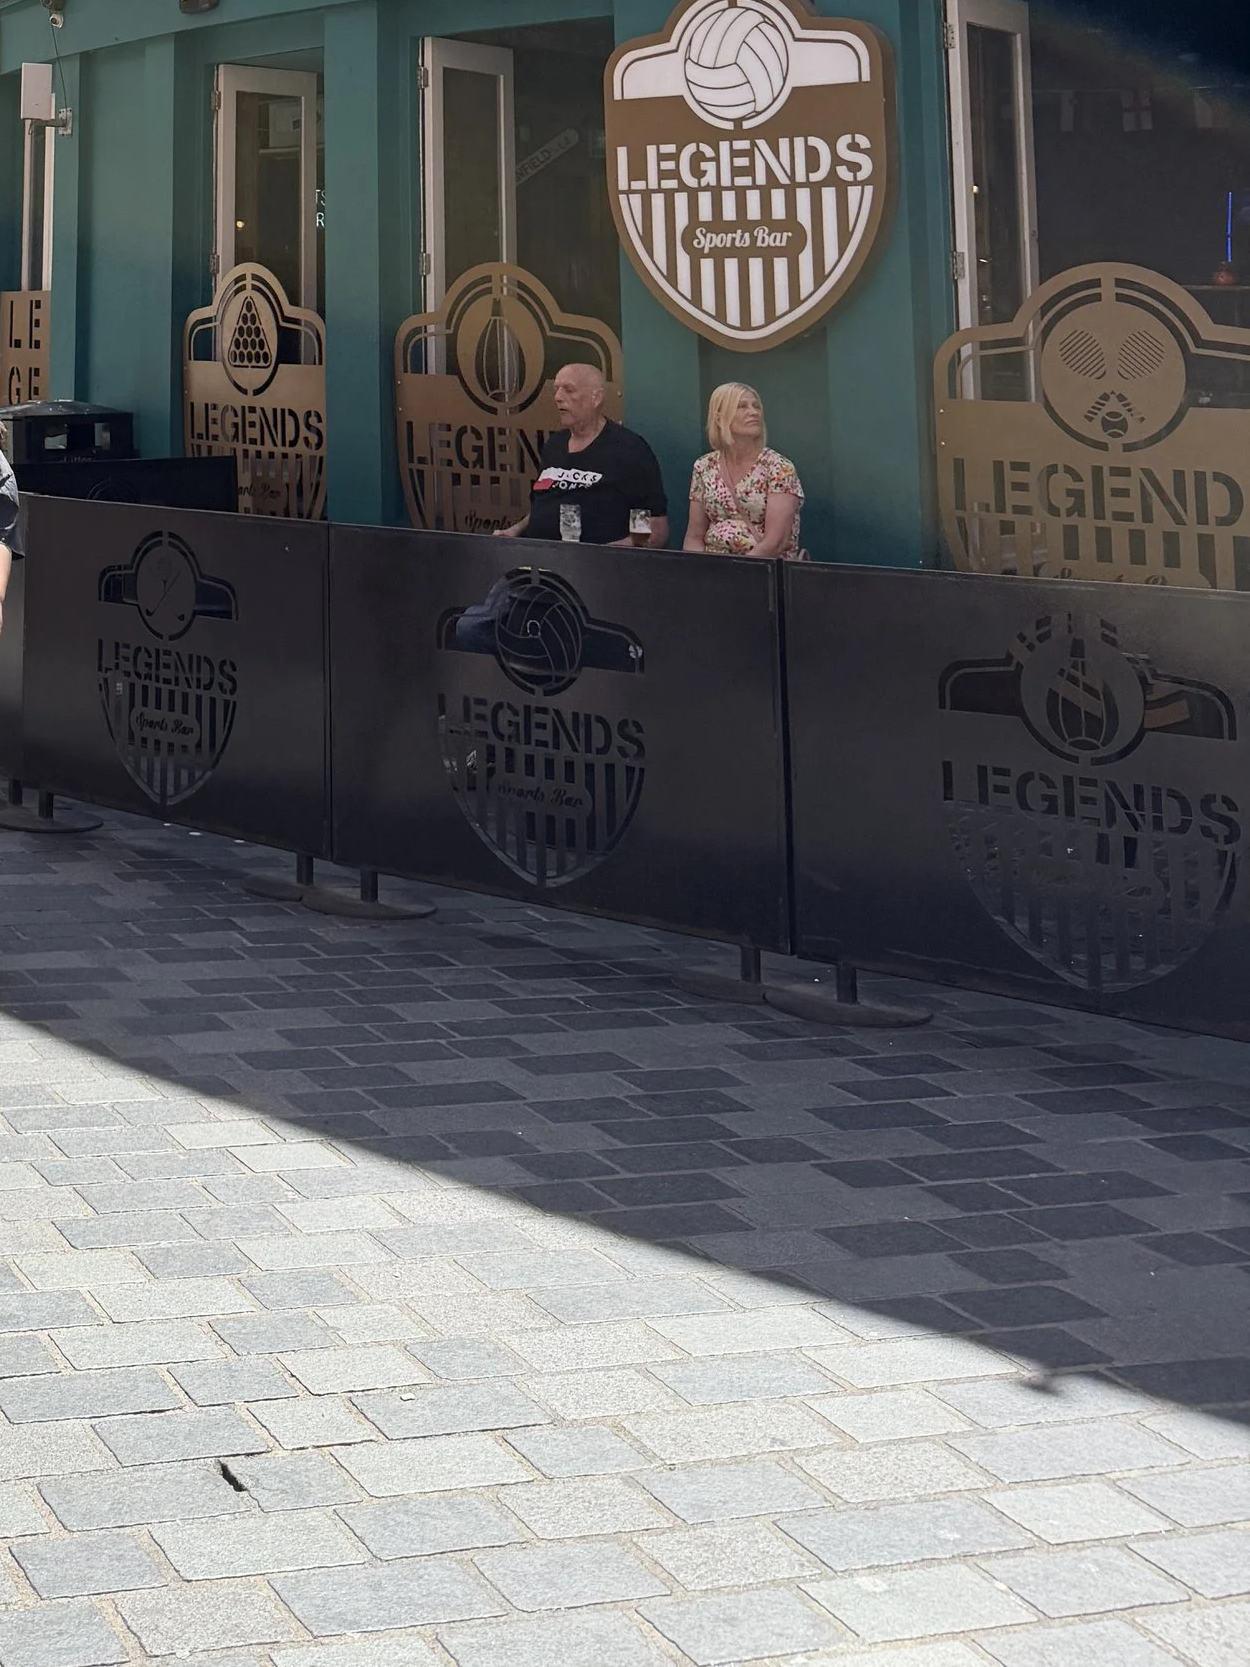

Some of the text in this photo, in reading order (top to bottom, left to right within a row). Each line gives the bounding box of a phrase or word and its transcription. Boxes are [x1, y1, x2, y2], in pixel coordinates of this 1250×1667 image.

[616, 133, 873, 191] LEGENDS
[693, 225, 792, 253] Sports Bar
[190, 402, 323, 451] LEGENDS
[405, 421, 547, 473] LEGEN
[953, 458, 1244, 527] LEGEND
[98, 638, 238, 696] LEGENDS
[136, 712, 168, 732] Sports
[437, 692, 646, 759] LEGENDS
[550, 787, 583, 807] Bar
[942, 760, 1242, 846] LEGENDS
